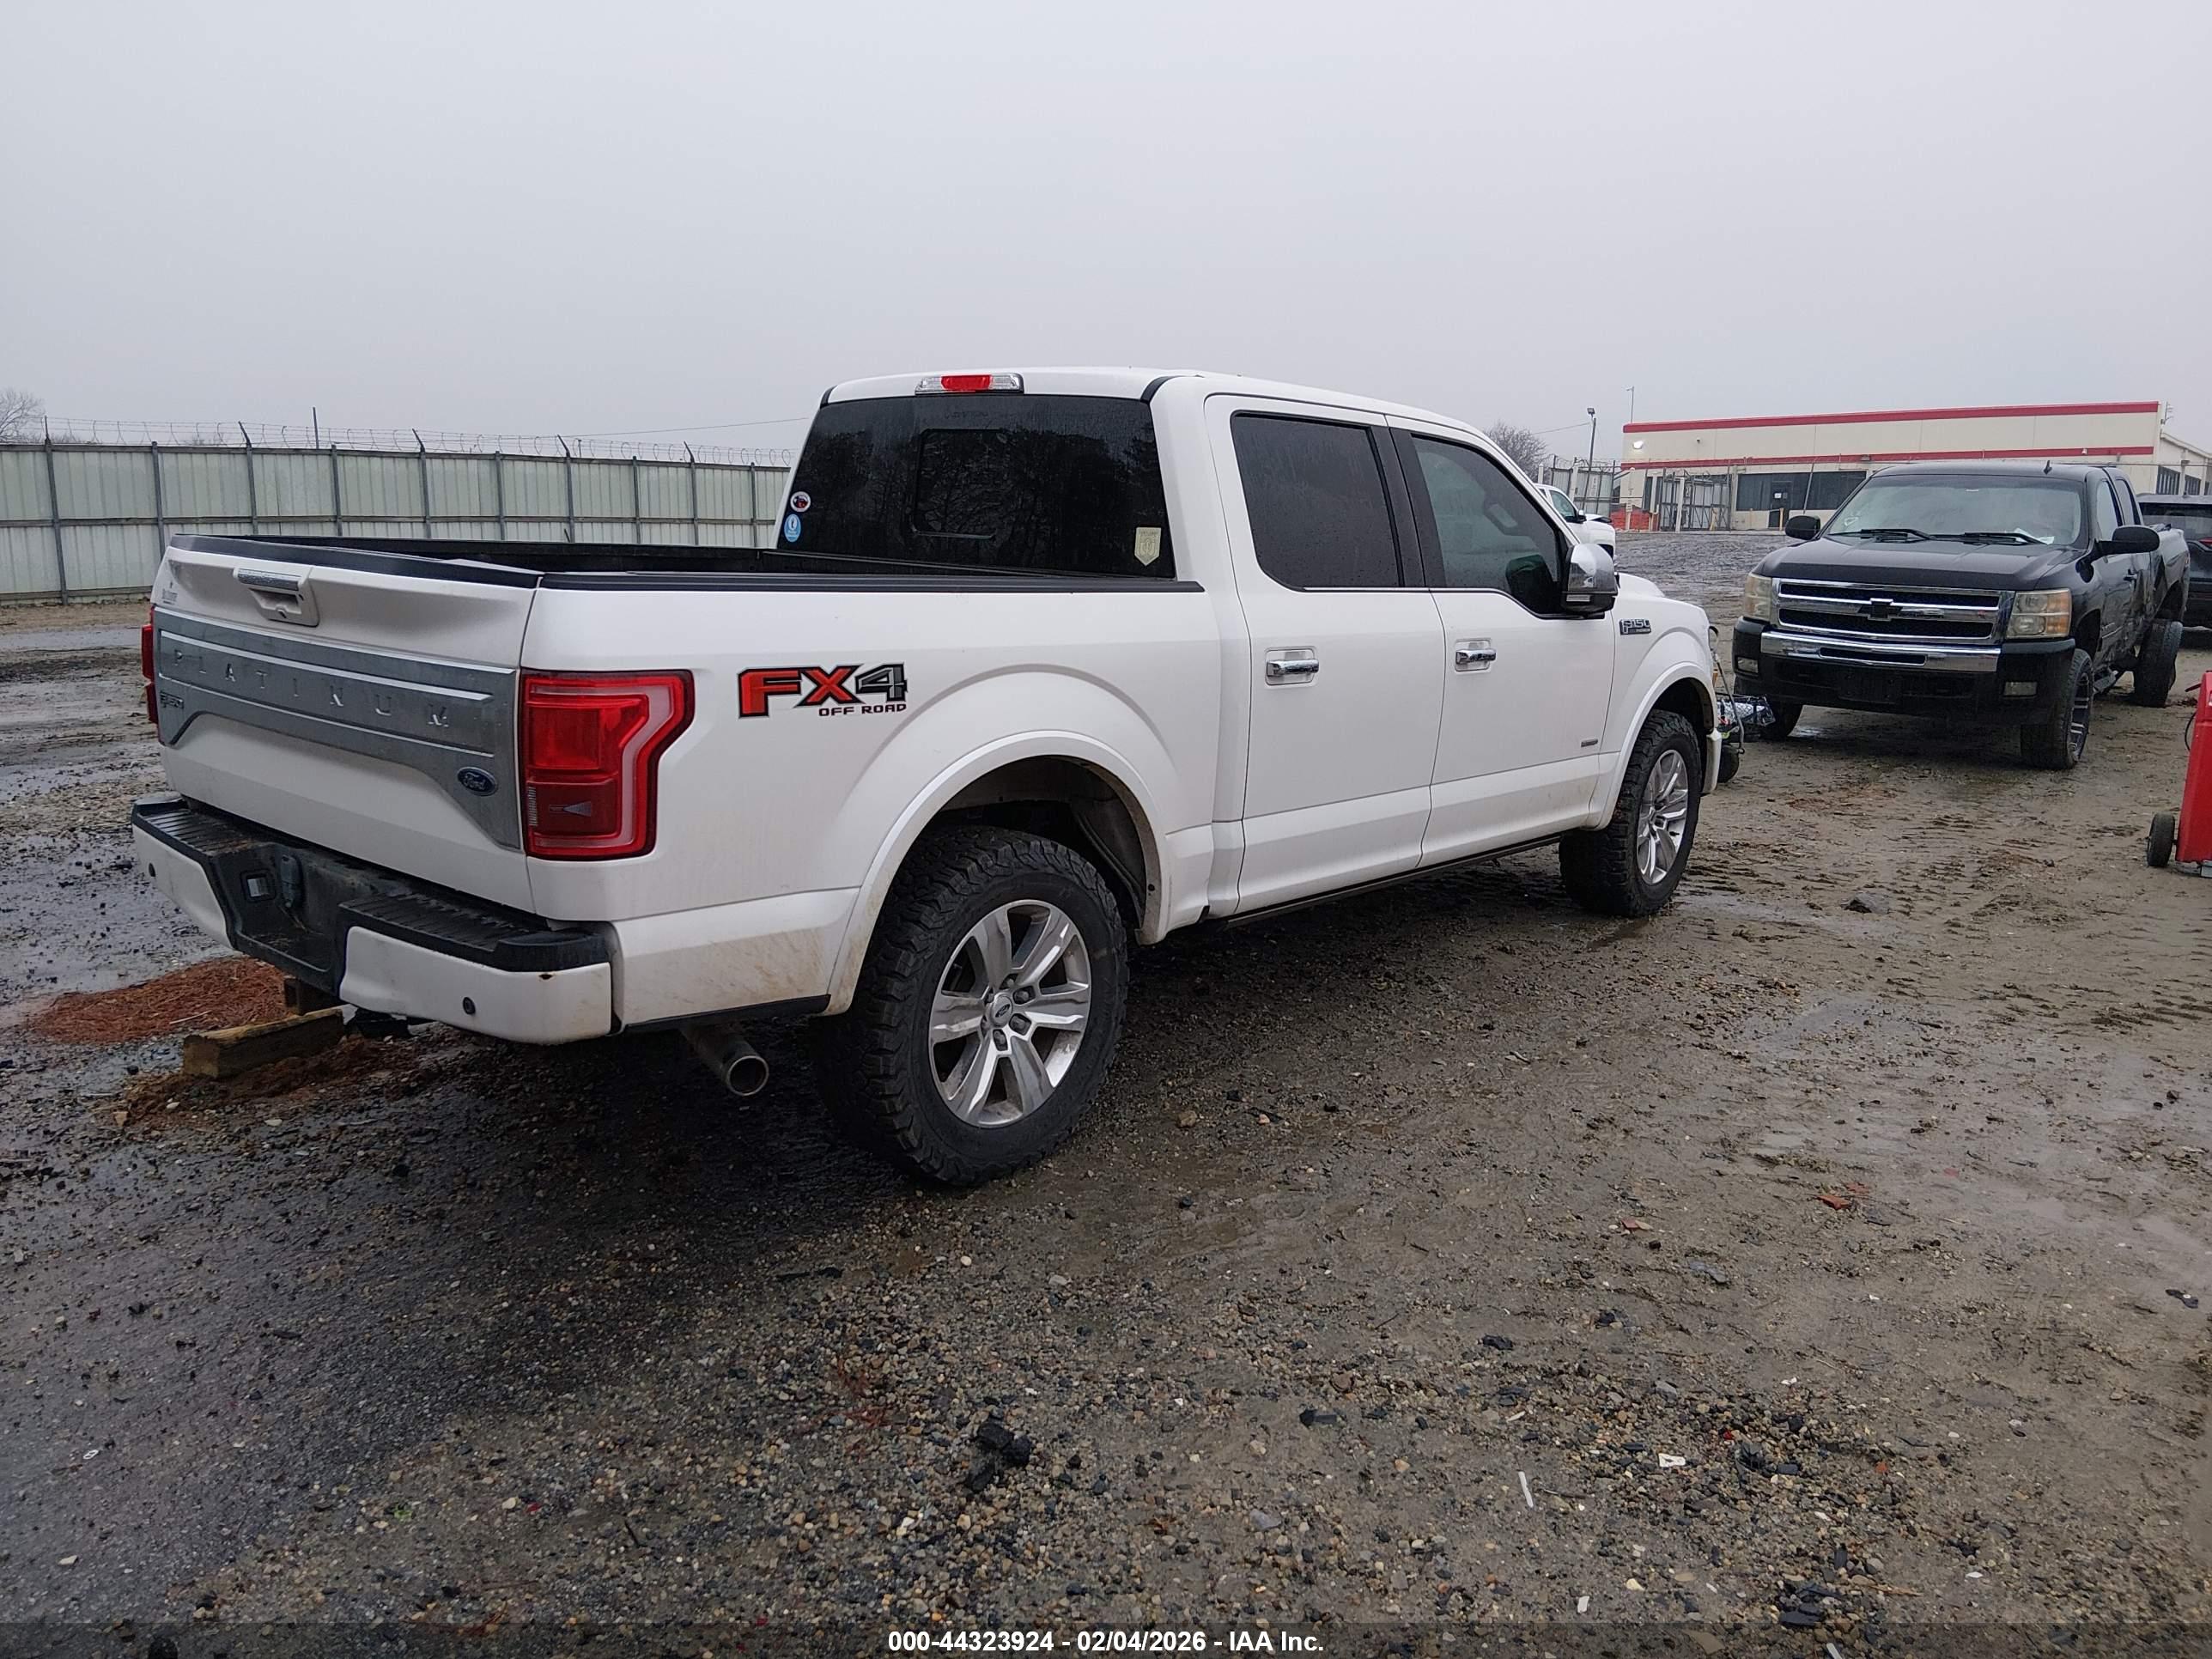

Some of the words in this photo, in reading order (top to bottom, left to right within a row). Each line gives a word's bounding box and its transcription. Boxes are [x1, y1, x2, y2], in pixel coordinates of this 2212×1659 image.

[173, 649, 450, 728] PLATINUM
[738, 662, 908, 719] FX4
[818, 706, 855, 717] OFF
[861, 703, 907, 714] ROAD
[460, 769, 492, 792] Ford
